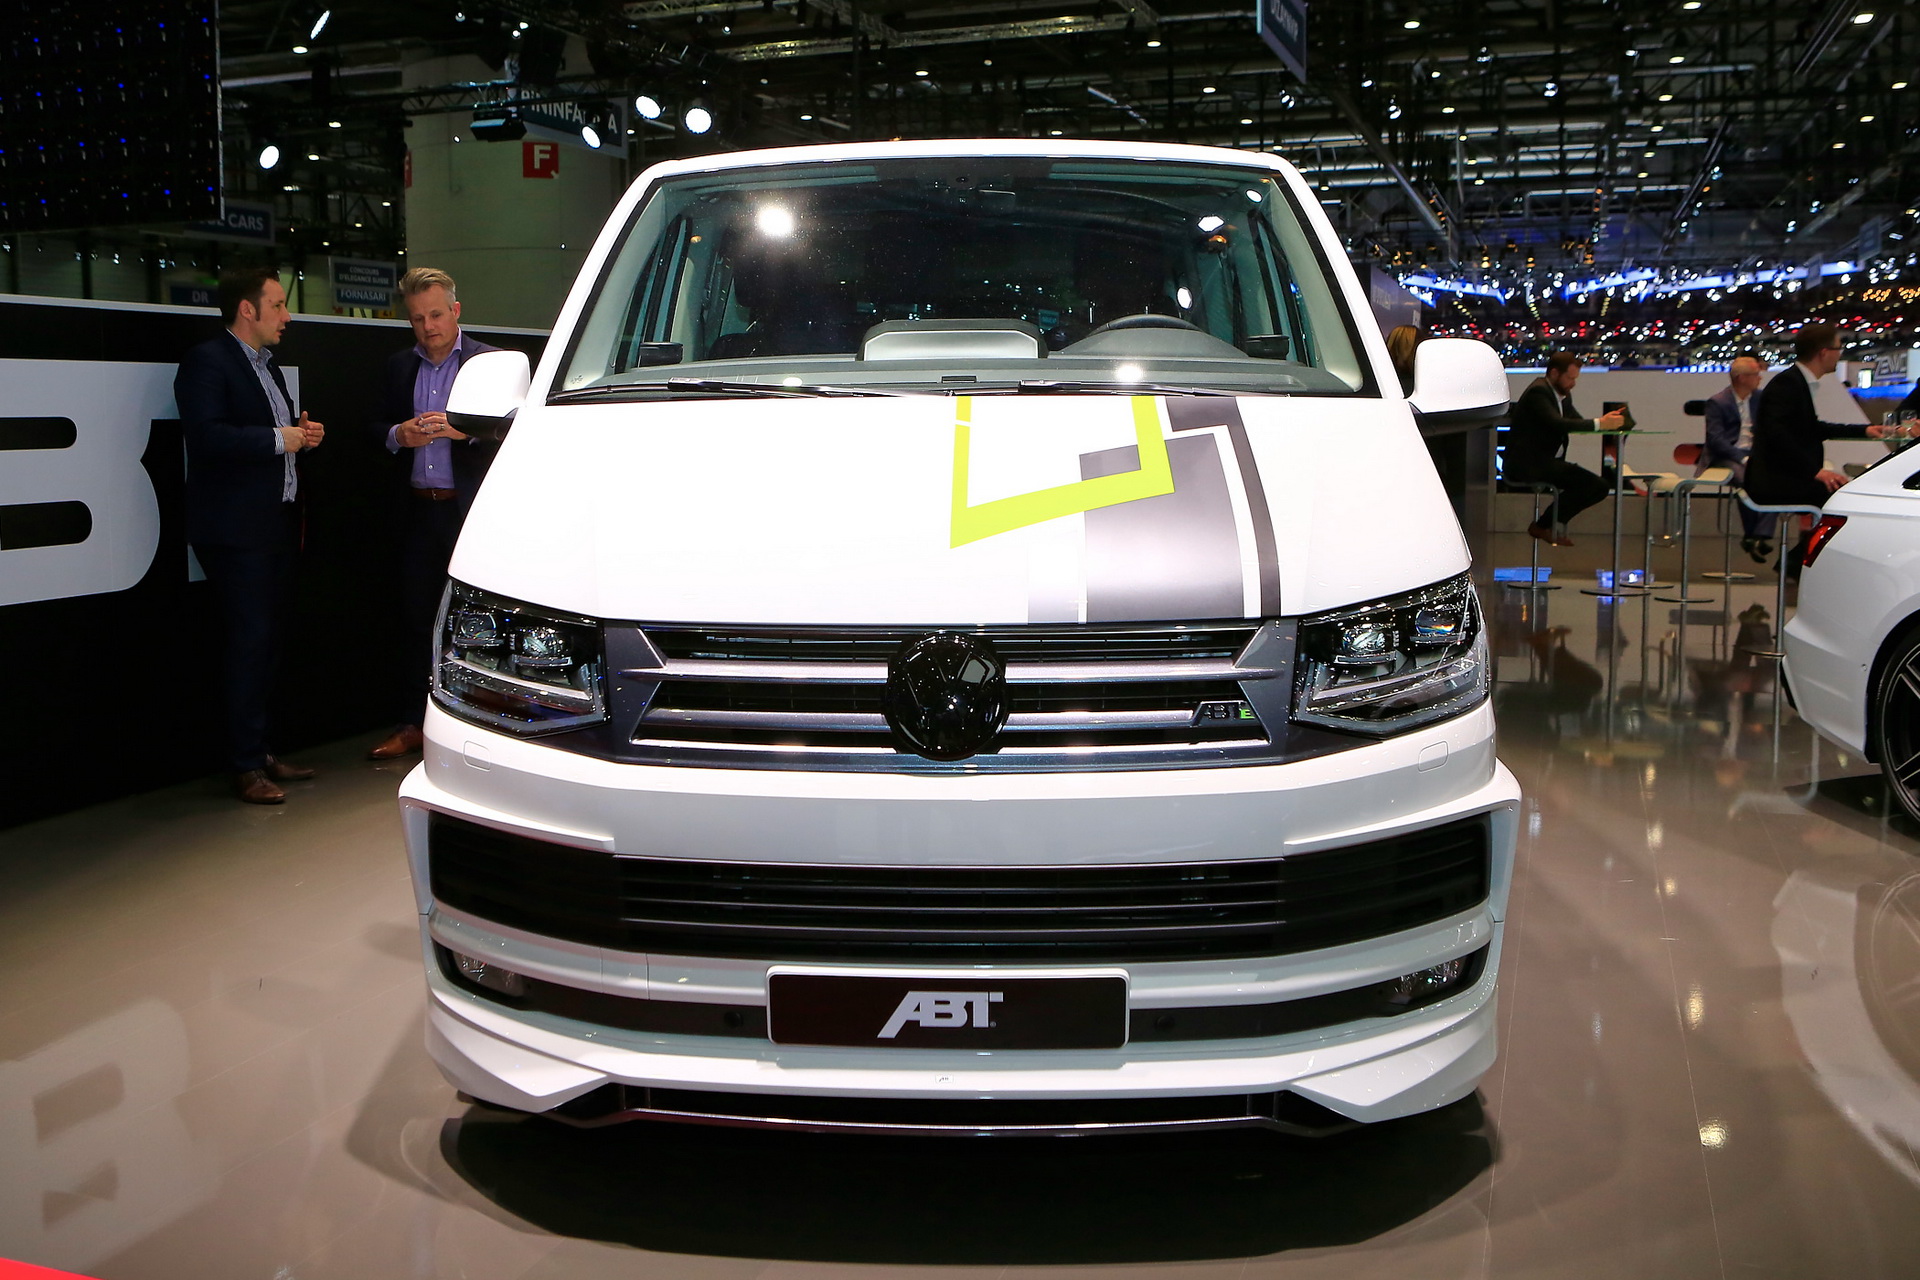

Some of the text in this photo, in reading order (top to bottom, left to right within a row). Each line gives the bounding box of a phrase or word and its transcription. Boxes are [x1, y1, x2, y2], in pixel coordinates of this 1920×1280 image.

[534, 144, 552, 169] F
[228, 213, 264, 232] CARS
[192, 291, 208, 303] DR
[340, 288, 386, 301] FORNASARI
[877, 990, 1004, 1038] ABT
